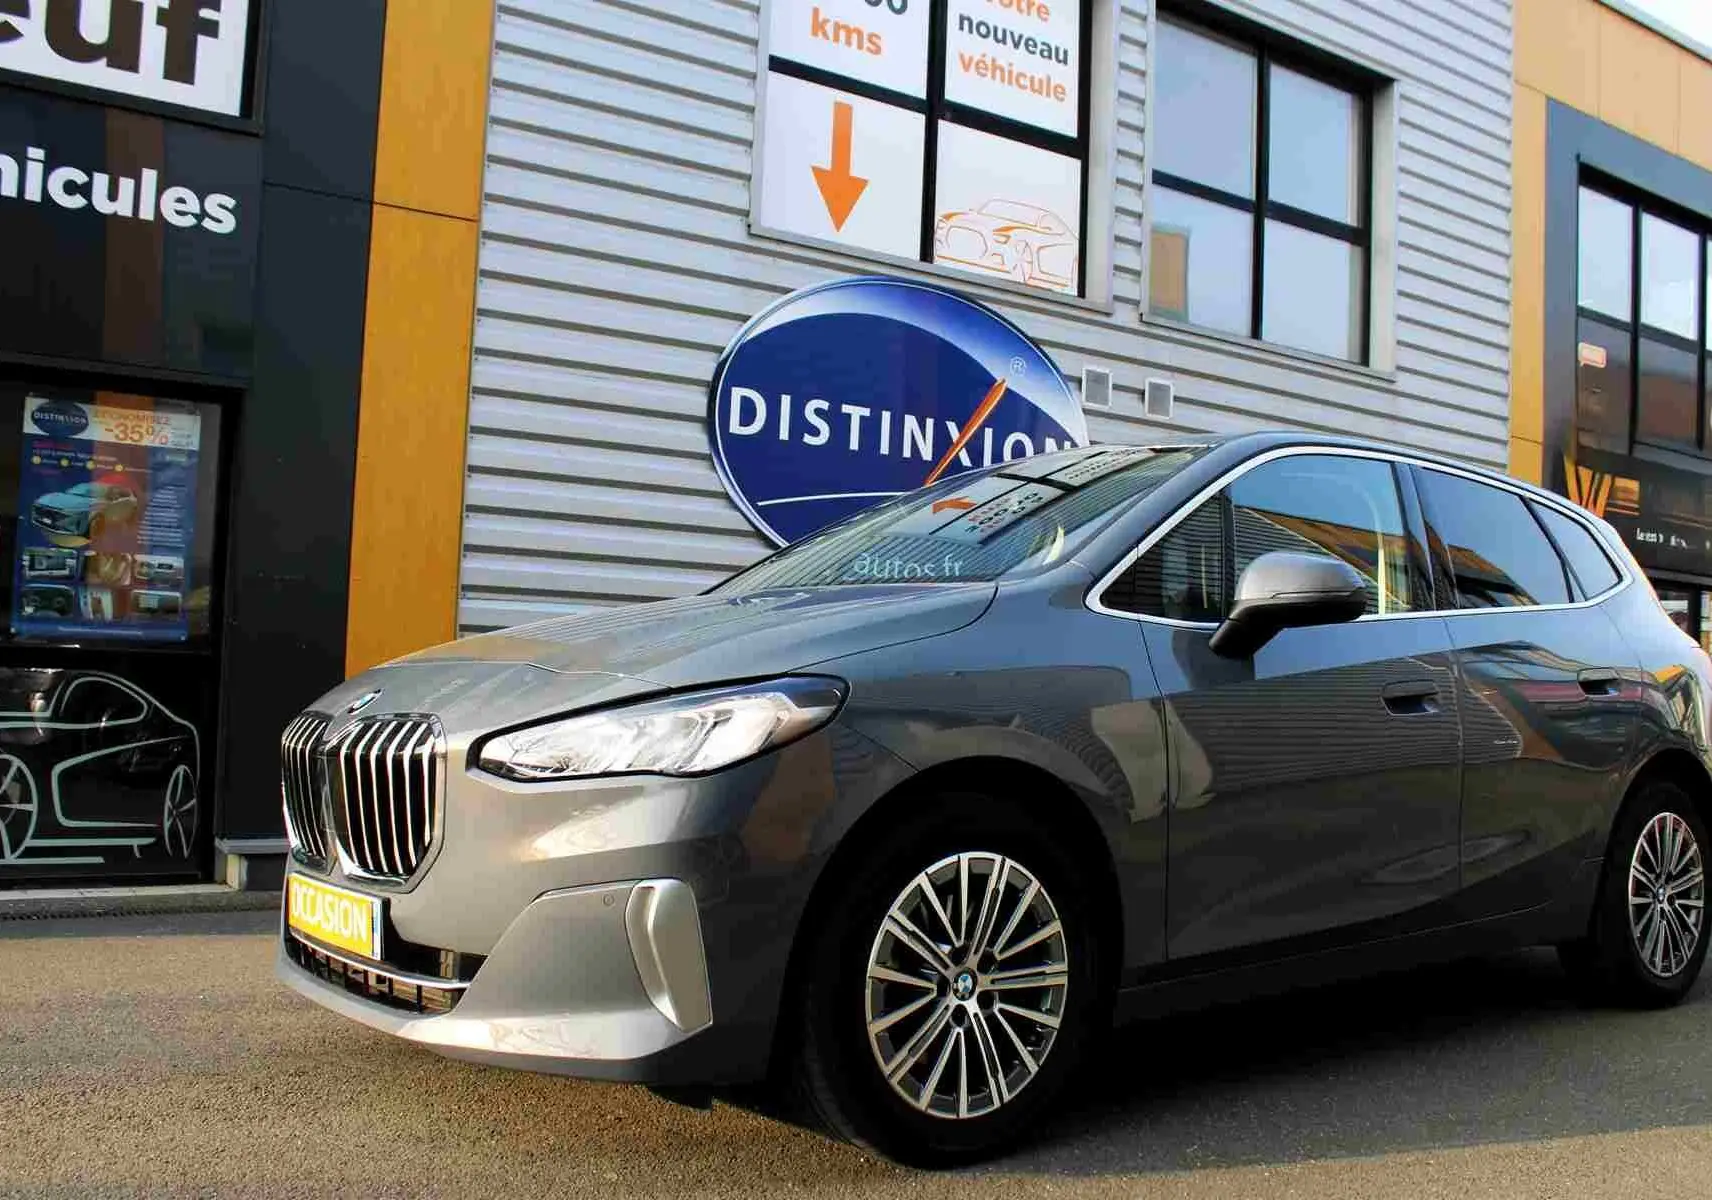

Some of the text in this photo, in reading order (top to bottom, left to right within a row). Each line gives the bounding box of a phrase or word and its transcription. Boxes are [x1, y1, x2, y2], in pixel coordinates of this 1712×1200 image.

[0, 0, 220, 85] uf
[810, 7, 883, 56] kms
[957, 13, 1069, 66] nouveau
[958, 51, 1067, 102] véhicule
[105, 421, 169, 446] -35%
[291, 882, 368, 943] OCCASION
